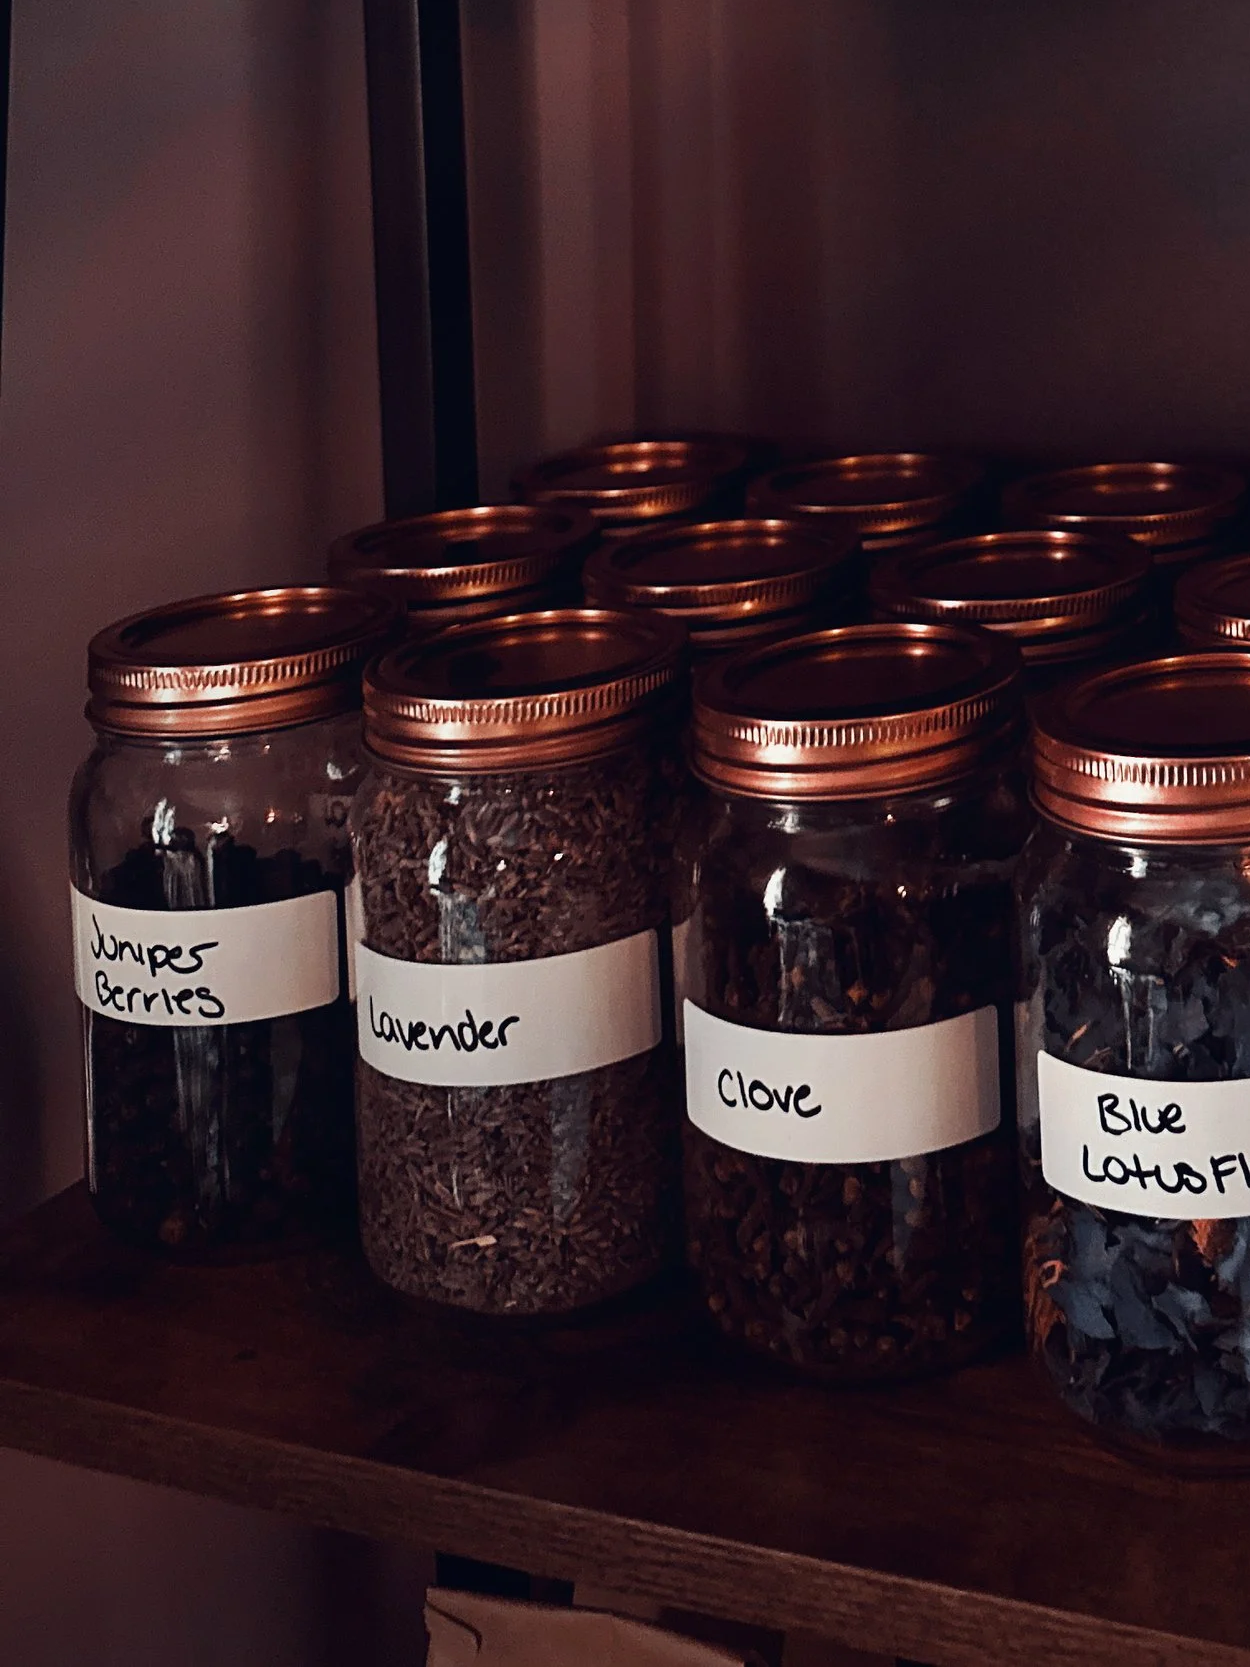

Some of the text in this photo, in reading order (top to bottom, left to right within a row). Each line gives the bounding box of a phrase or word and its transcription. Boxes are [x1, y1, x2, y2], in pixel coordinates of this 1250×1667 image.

[90, 912, 219, 977] Juniper
[95, 970, 225, 1018] Berries
[369, 994, 520, 1052] Lavender
[717, 1068, 822, 1118] Clove
[1097, 1093, 1186, 1135] Blue
